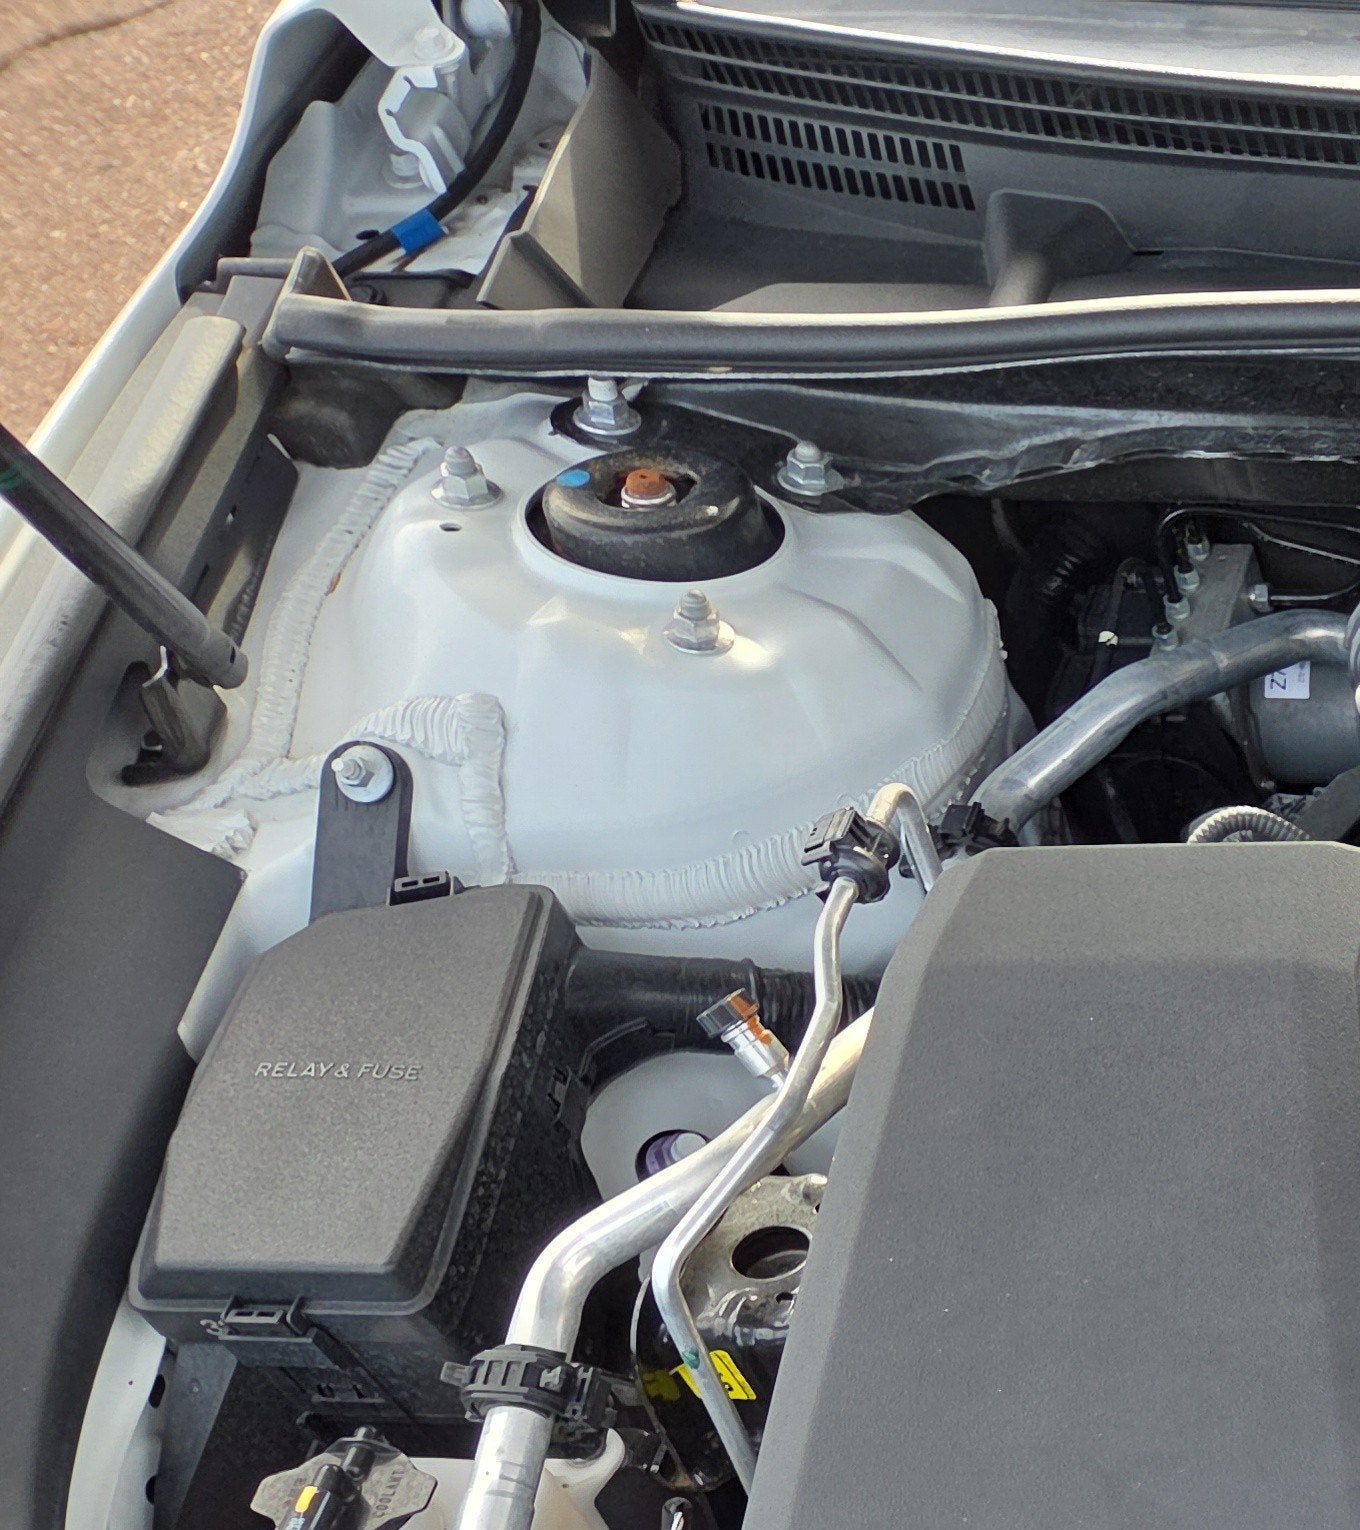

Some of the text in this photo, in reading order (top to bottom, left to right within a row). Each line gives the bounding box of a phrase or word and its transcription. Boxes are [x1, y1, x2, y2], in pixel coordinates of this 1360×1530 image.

[256, 1061, 421, 1081] RELAY & FUSE
